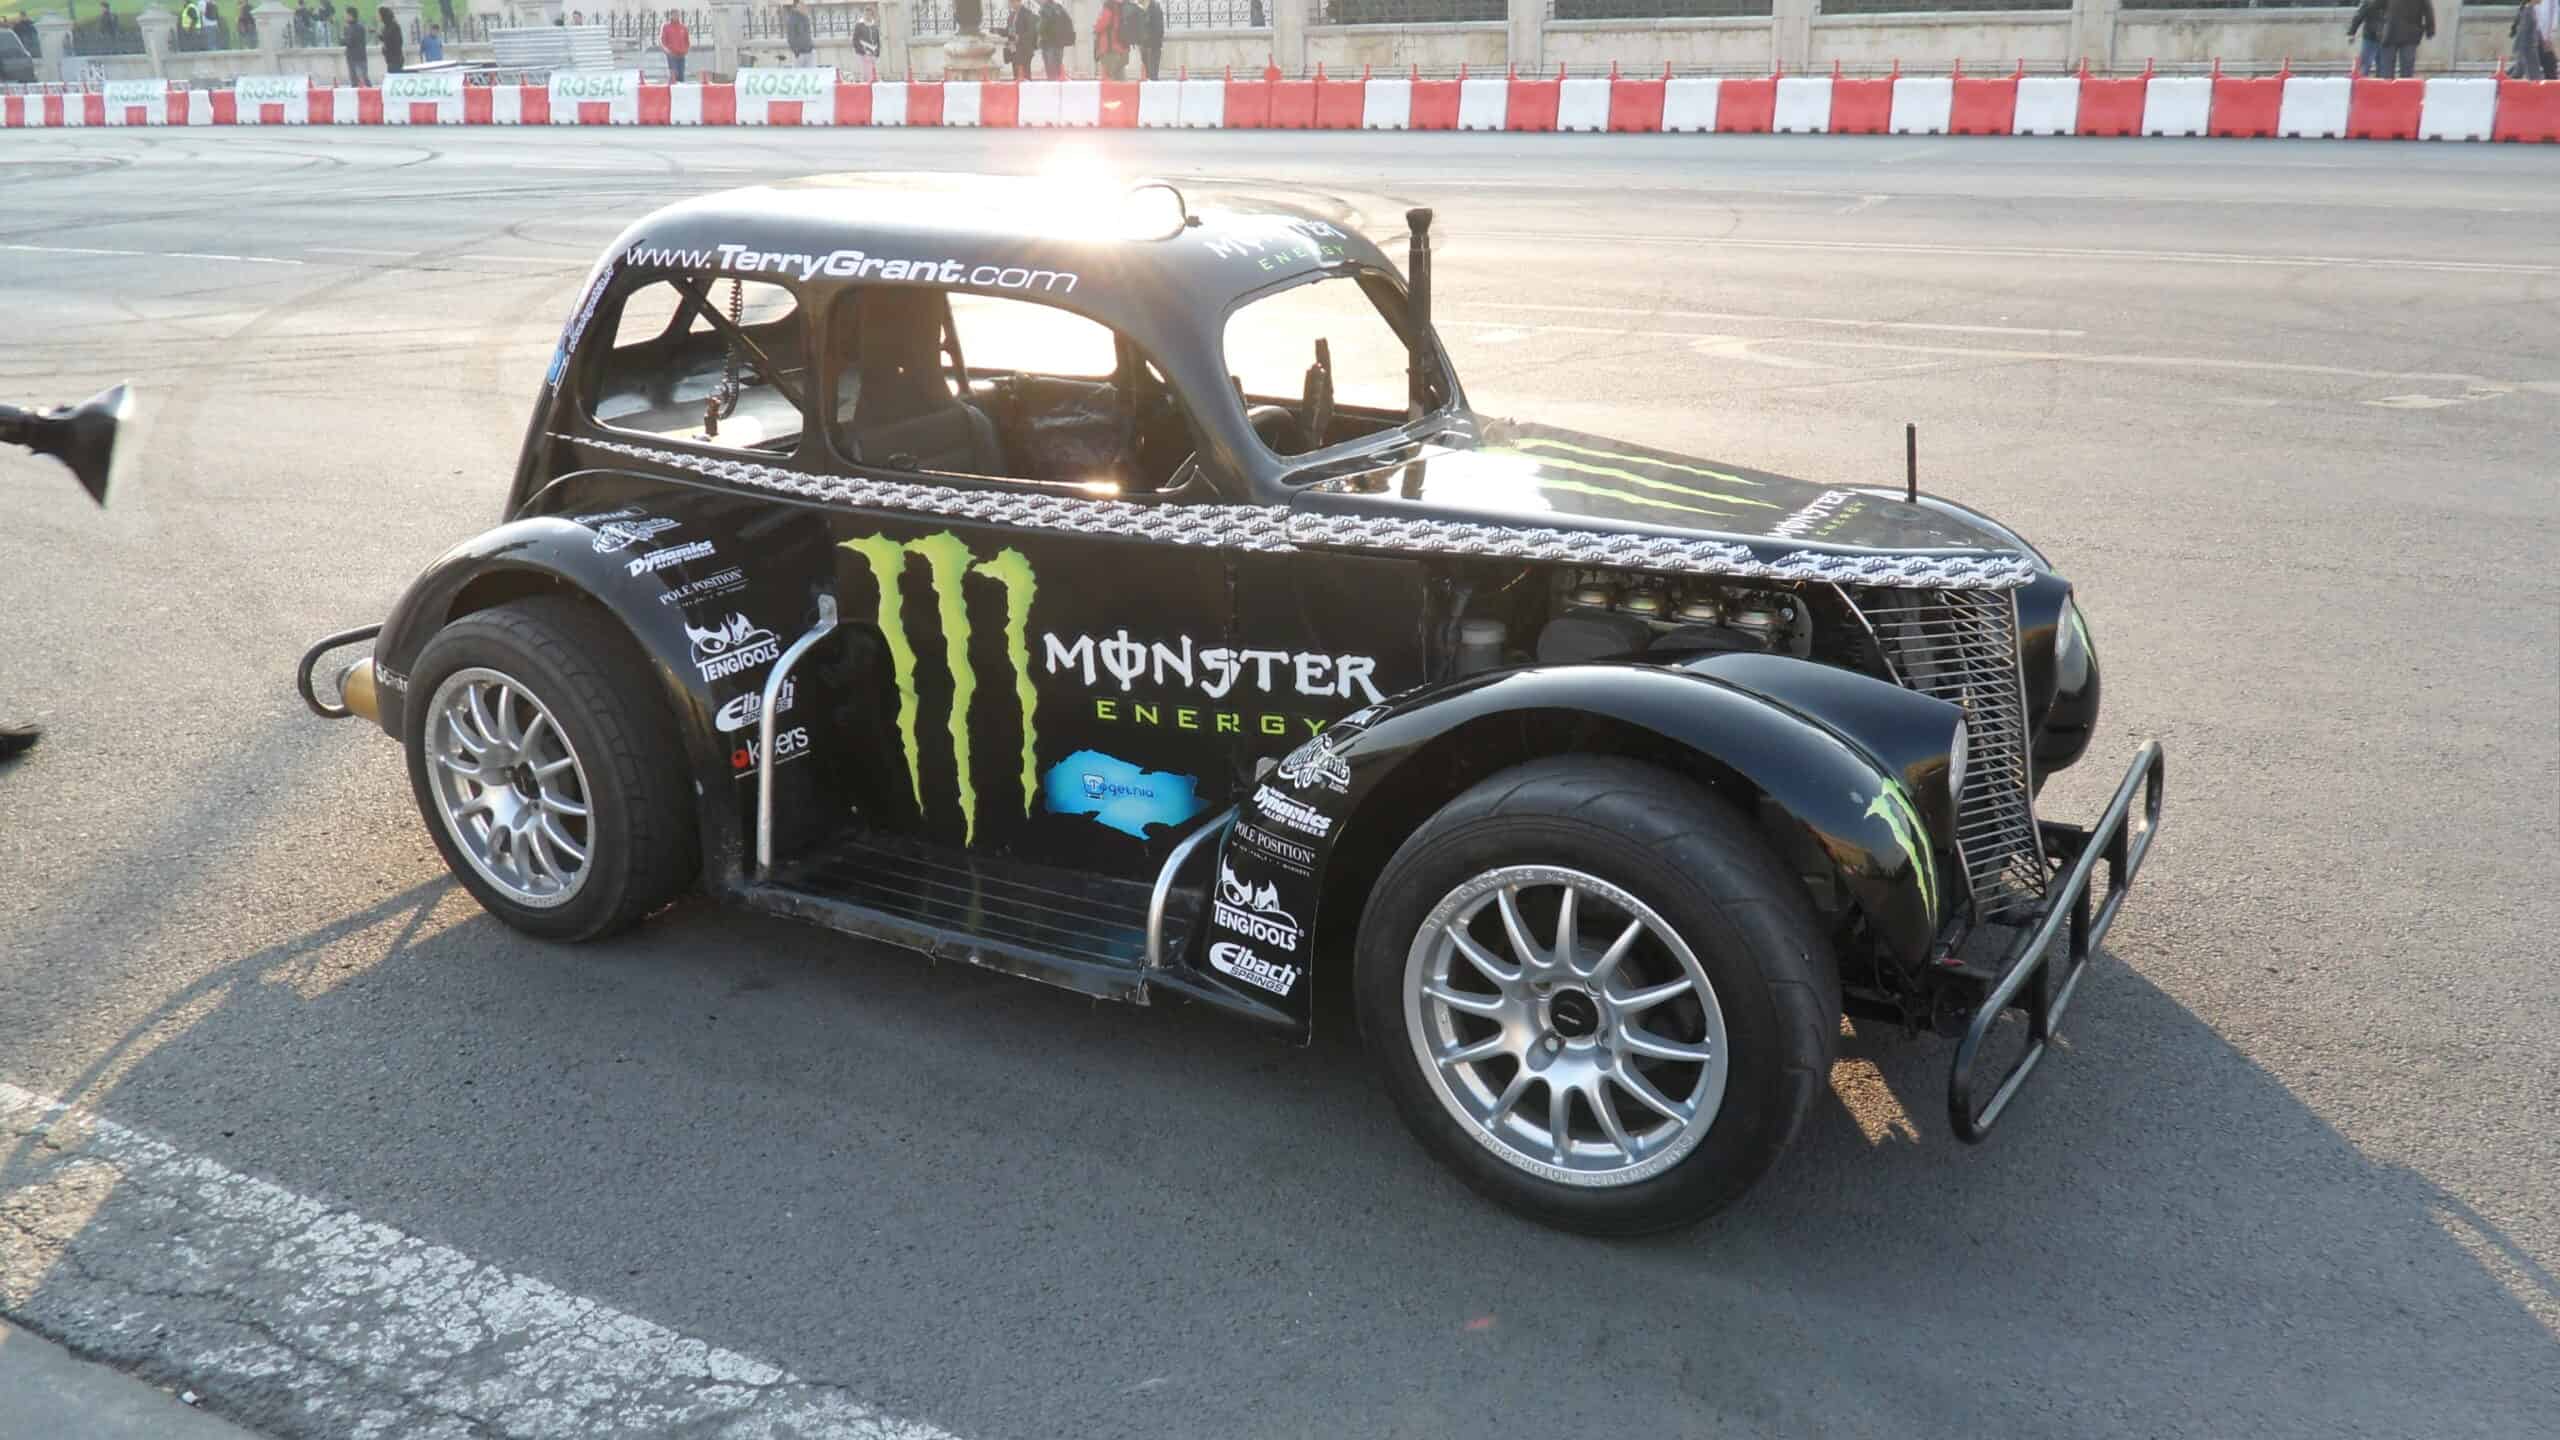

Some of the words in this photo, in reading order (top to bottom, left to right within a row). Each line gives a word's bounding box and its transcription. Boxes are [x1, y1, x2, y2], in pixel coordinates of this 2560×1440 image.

[240, 80, 297, 99] ROSAL
[389, 77, 454, 98] ROSAL
[556, 75, 627, 97] ROSAL
[744, 71, 823, 97] ROSAL
[625, 243, 1079, 294] www.TerryGrant.com
[624, 540, 714, 578] Dynamics
[659, 584, 691, 605] POLE
[1043, 629, 1387, 705] MONSTER
[1095, 700, 1327, 738] ENERGY
[1252, 784, 1333, 830] Dynamics
[1262, 808, 1287, 824] ALLOY
[1234, 820, 1257, 842] POLE
[1257, 832, 1312, 863] POSITION
[1213, 900, 1298, 952] TENGTOOLS
[1208, 942, 1297, 987] Eibach
[1230, 965, 1286, 994] SPRINGS
